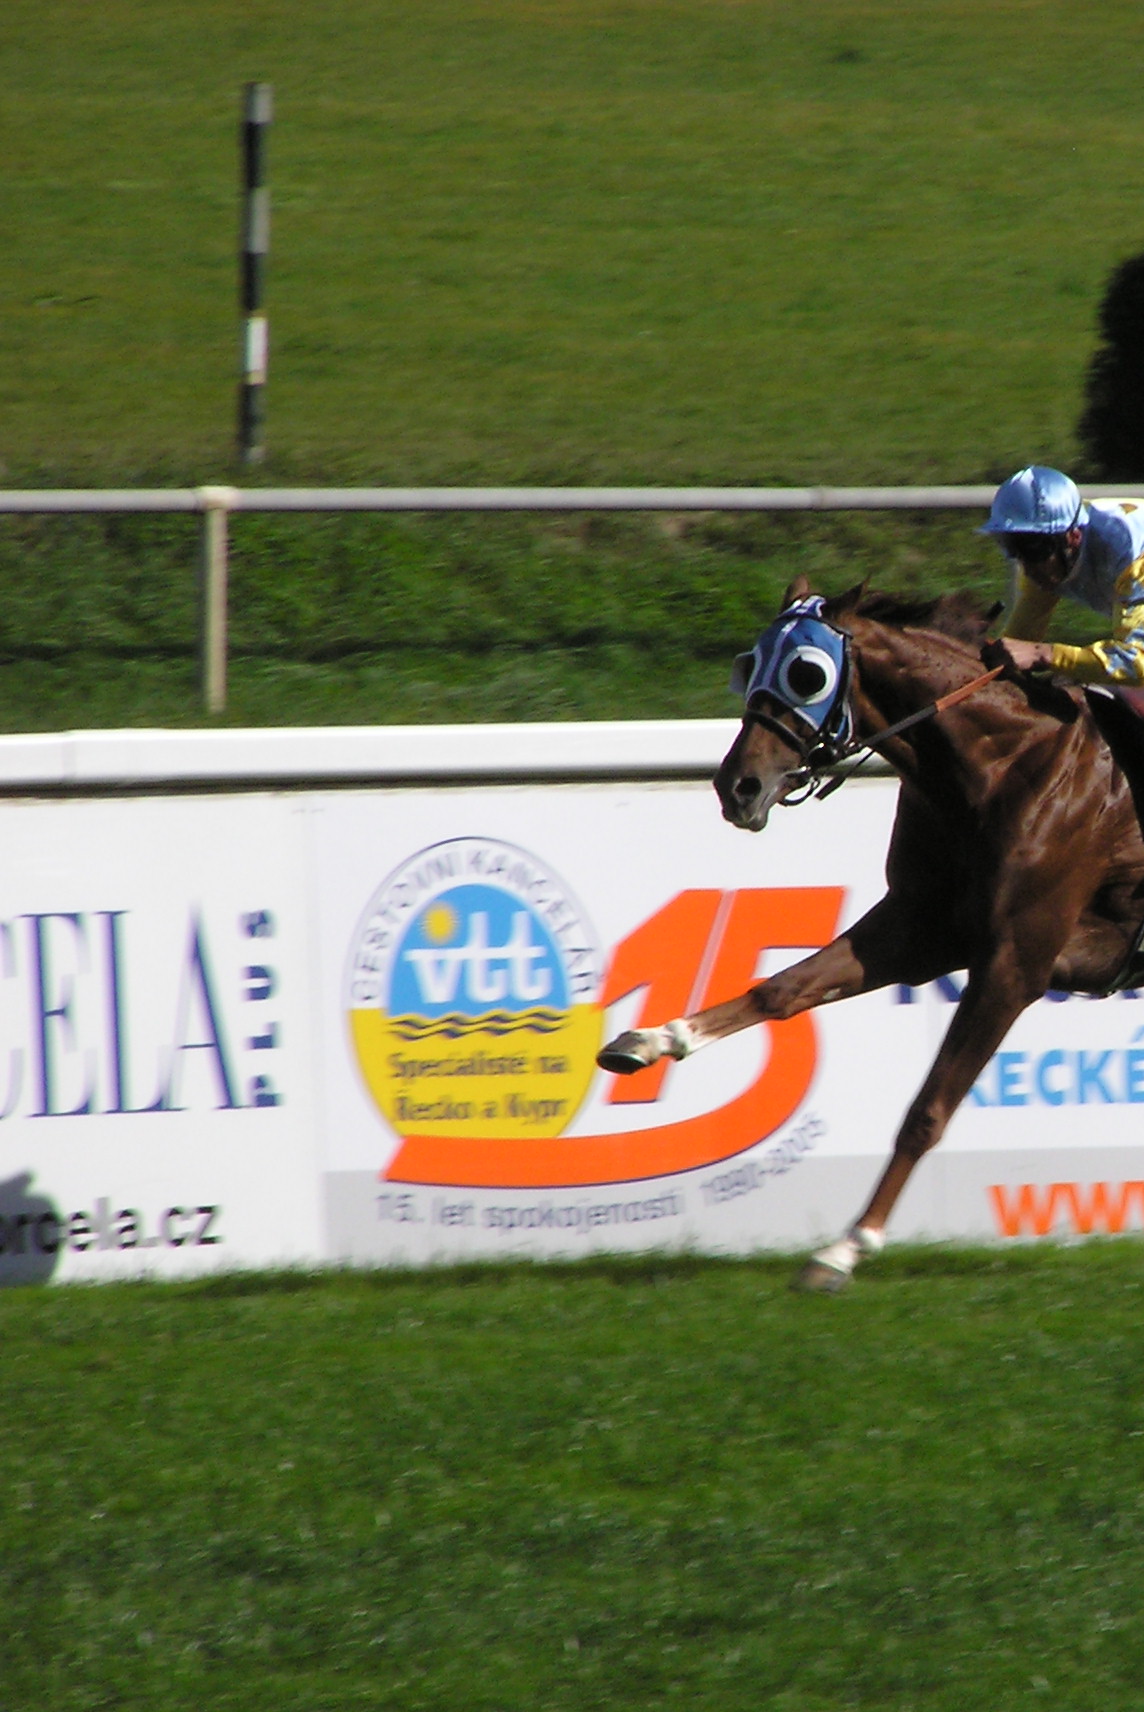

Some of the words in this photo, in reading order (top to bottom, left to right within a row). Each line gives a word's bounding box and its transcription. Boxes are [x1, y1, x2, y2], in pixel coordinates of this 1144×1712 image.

[403, 910, 552, 1003] vtt
[240, 909, 286, 1108] PLUS
[537, 1056, 566, 1075] na
[481, 1100, 500, 1119] a
[0, 1197, 222, 1254] rcela.cz
